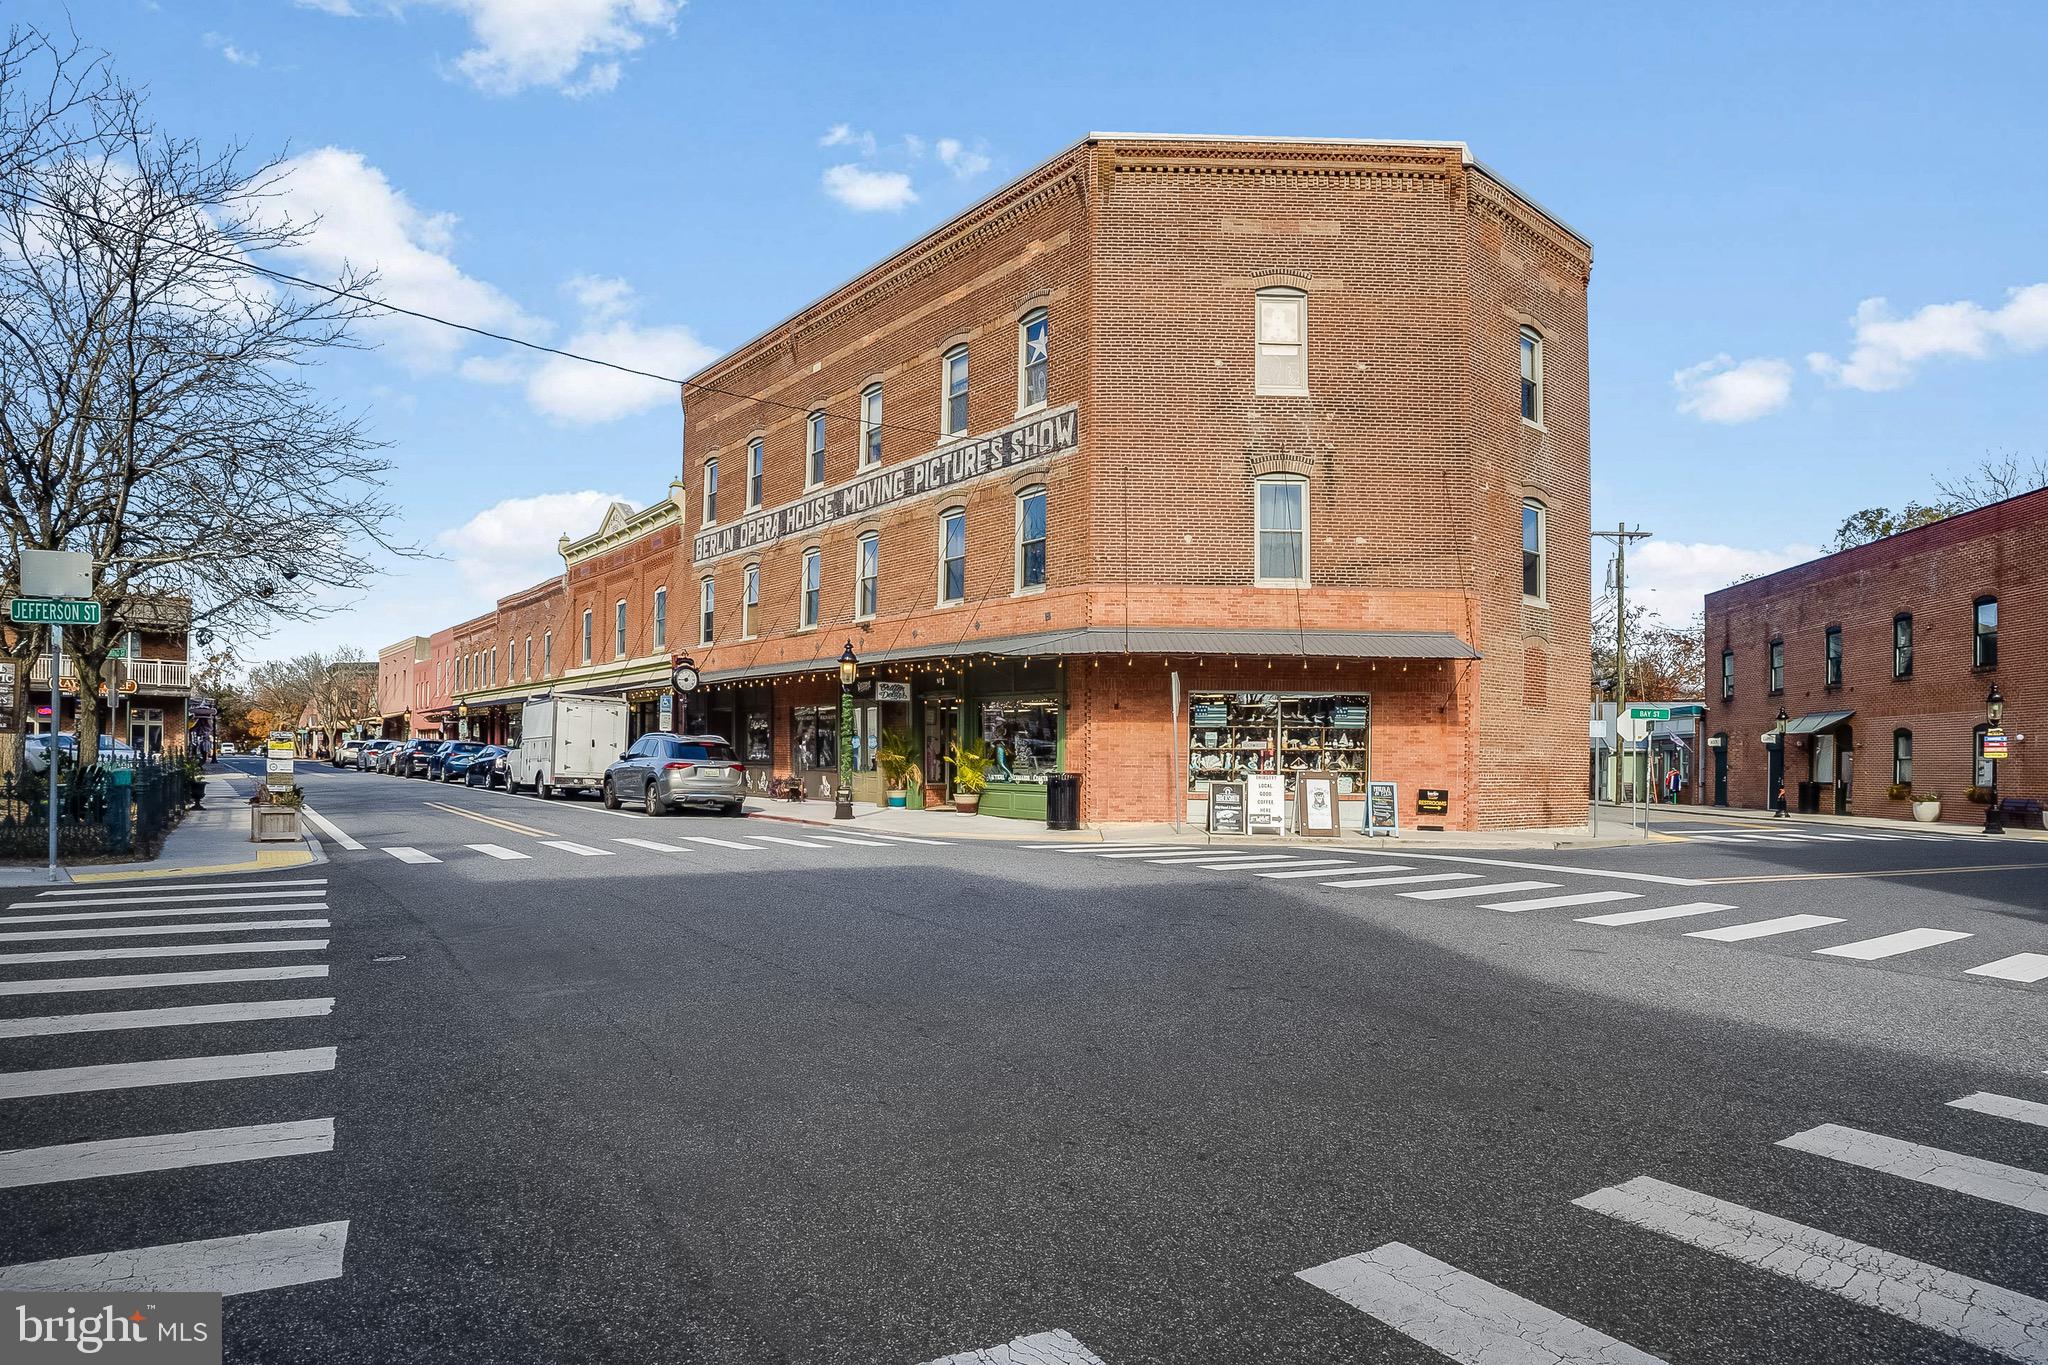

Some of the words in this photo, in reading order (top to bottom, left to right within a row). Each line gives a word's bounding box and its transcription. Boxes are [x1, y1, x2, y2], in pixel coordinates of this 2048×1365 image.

[696, 528, 734, 560] BERLIN
[740, 513, 780, 547] OPERA
[843, 470, 905, 516] MOVING
[913, 437, 1003, 493] PICTURES
[1011, 412, 1075, 462] SHOW
[14, 602, 79, 620] JEFFERSON
[84, 605, 97, 621] ST
